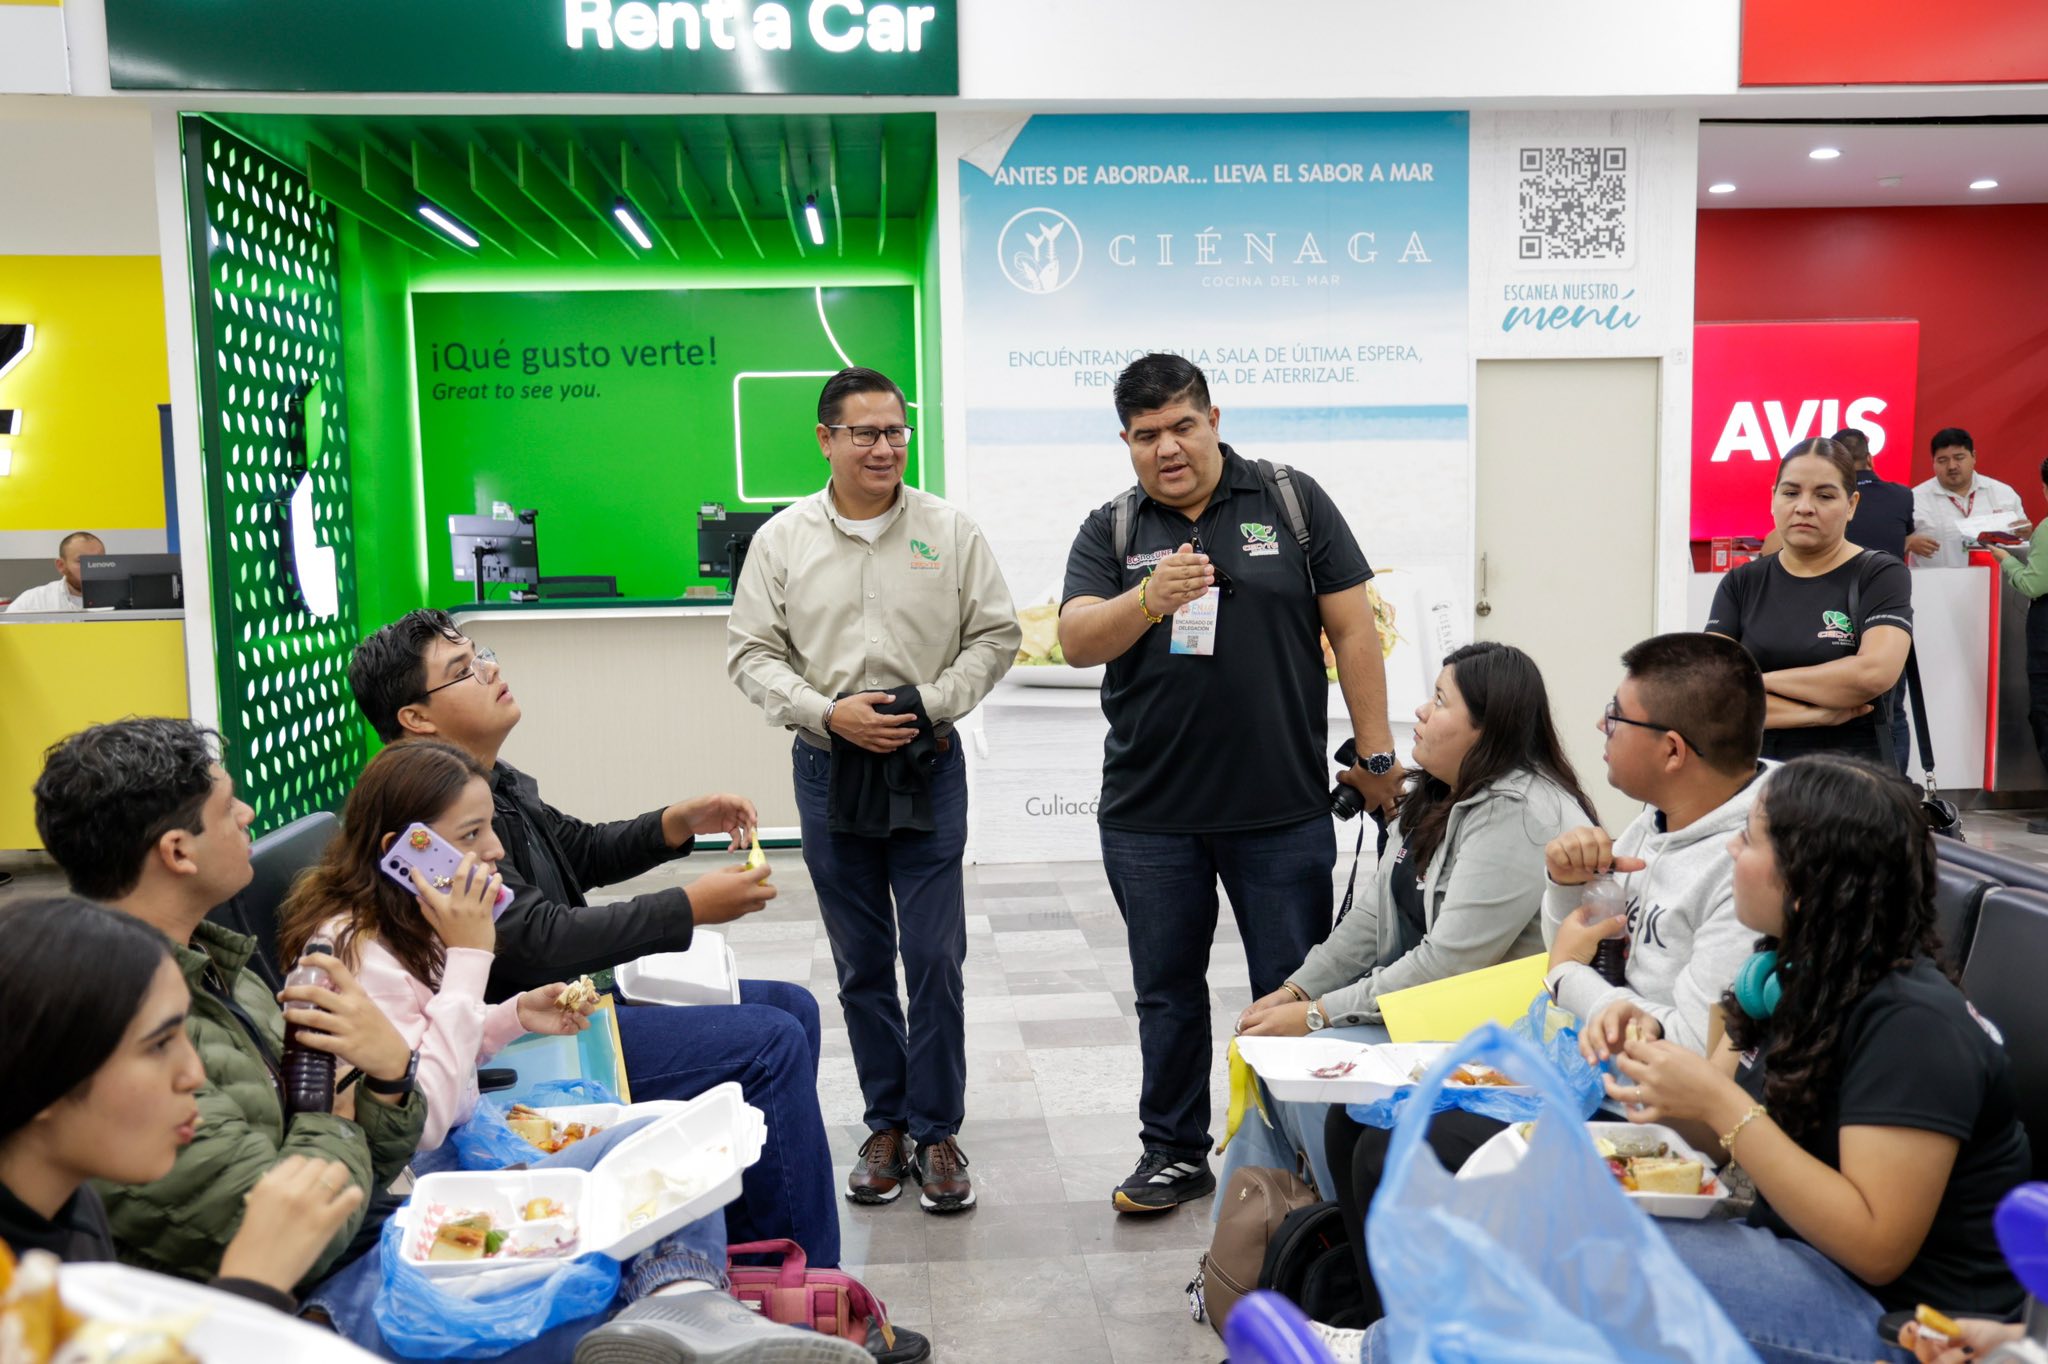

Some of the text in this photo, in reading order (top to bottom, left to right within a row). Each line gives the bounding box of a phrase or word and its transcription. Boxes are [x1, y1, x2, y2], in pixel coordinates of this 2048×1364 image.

[565, 0, 935, 52] Rent a Car
[994, 162, 1434, 186] ANTES DE ABORDAR... LLEVA EL SABOR A MAR
[1108, 226, 1432, 266] CIÉNAGA
[1202, 274, 1341, 288] COCINA DEL MAR
[1503, 283, 1619, 301] ESCANEA NUESTRO
[1501, 288, 1641, 333] menú
[432, 336, 717, 376] ¡Qué gusto verte!
[1190, 348, 1211, 365] LA
[1216, 347, 1260, 364] SALA
[1265, 347, 1287, 363] DE
[1292, 342, 1353, 364] ÚLTIMA
[1357, 345, 1424, 364] ESPERA,
[1234, 368, 1257, 384] DE
[1261, 366, 1360, 384] ATERRIZAJE.
[432, 382, 602, 403] Great to see you.
[1710, 396, 1888, 462] AVIS
[87, 561, 117, 569] Lenovo
[1025, 793, 1100, 817] Culiacó
